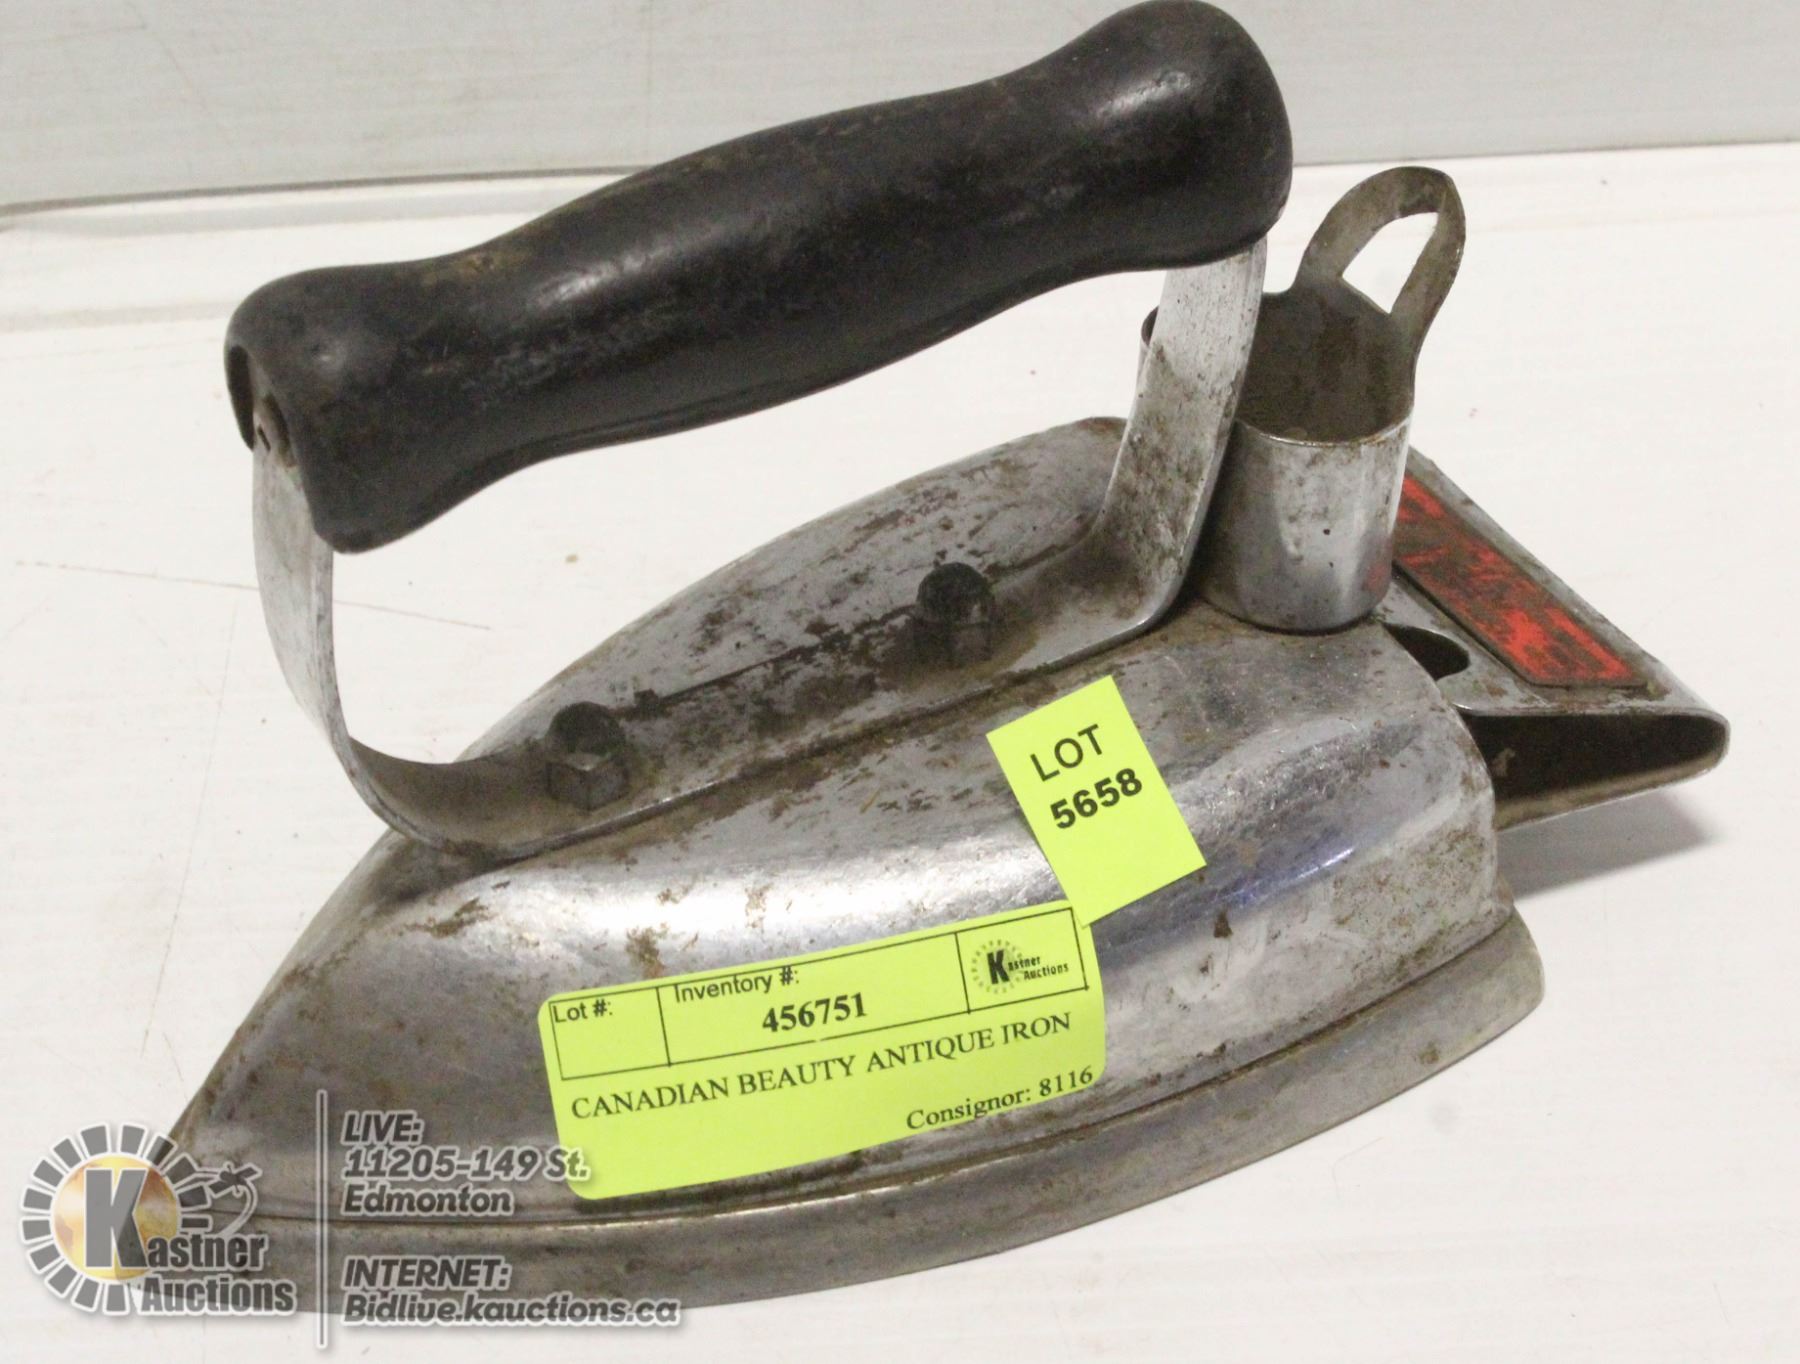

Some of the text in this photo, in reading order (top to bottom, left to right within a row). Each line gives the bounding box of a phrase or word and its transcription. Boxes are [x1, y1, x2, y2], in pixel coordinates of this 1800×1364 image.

[1030, 723, 1102, 782] LOT
[1050, 768, 1143, 829] 5658
[675, 973, 772, 1004] Inventory
[1023, 963, 1070, 981] Auctions
[553, 1004, 587, 1023] Lot
[762, 991, 867, 1033] 456751
[571, 1012, 1072, 1119] CANADIAN BEAUTY ANTIQUE IRON
[906, 1065, 1093, 1131] Consignor: 8116
